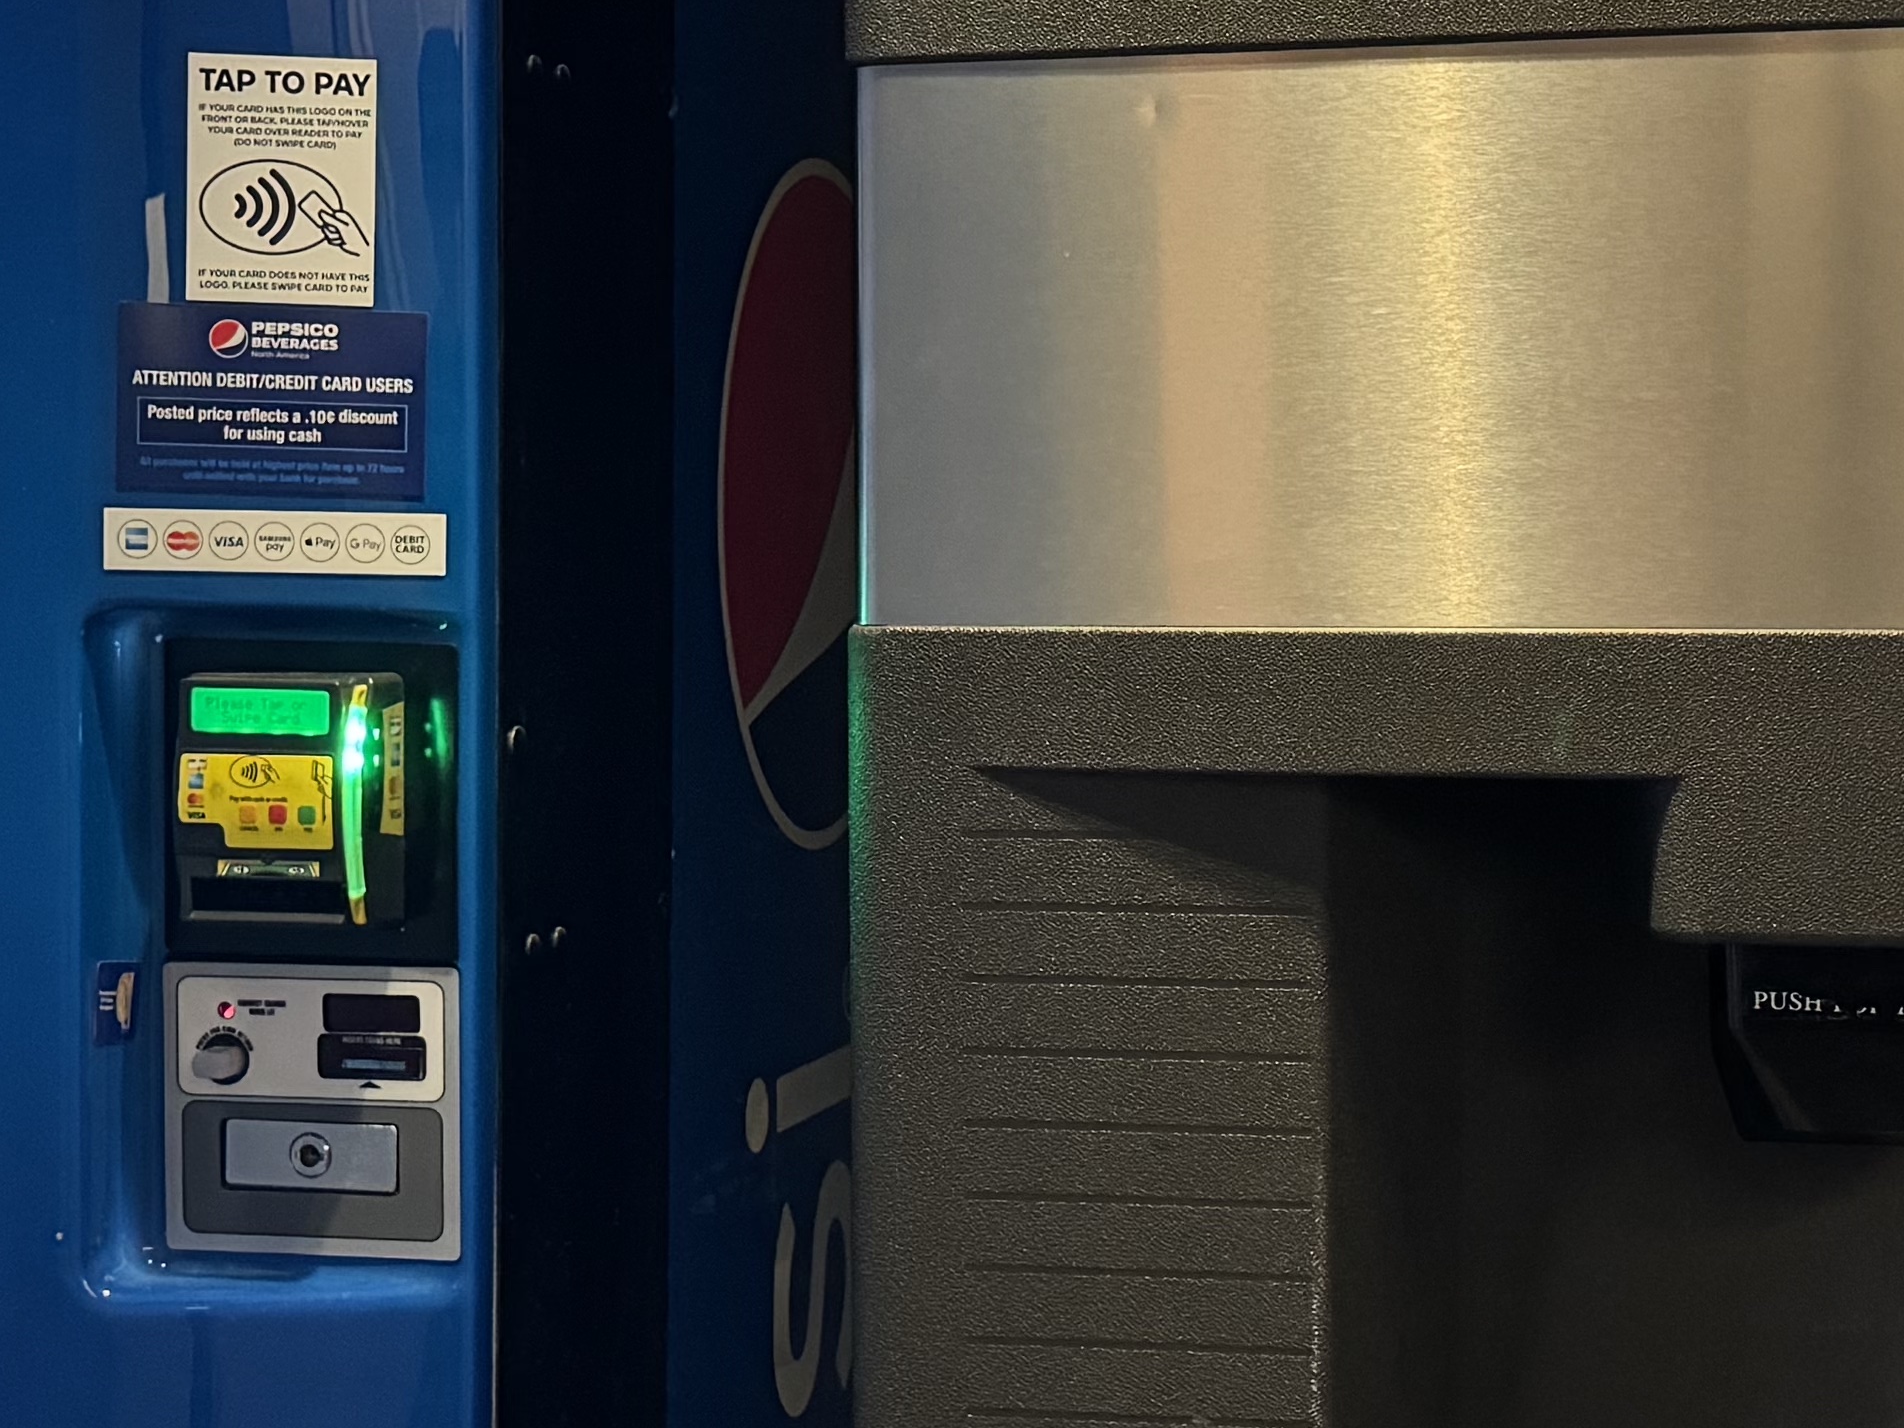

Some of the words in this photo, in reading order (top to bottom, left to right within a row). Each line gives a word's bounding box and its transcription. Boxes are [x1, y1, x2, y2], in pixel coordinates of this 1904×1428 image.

[199, 68, 256, 92] TAP
[265, 70, 305, 94] TO
[315, 72, 371, 96] PAY
[209, 104, 234, 112] YOUR
[237, 105, 263, 113] CARD
[266, 106, 284, 114] HAS
[287, 107, 306, 115] THIS
[309, 107, 336, 116] LOGO
[338, 108, 353, 116] ON
[355, 109, 371, 117] THE
[235, 115, 248, 123] OR
[280, 117, 314, 126] PLEASE
[208, 126, 233, 134] YOUR
[236, 127, 261, 135] CARD
[265, 128, 289, 136] OVER
[291, 129, 329, 137] READER
[331, 130, 343, 138] TO
[254, 139, 272, 147] NOT
[275, 139, 304, 148] SWIPE
[209, 269, 236, 277] YOUR
[239, 270, 266, 278] CARD
[269, 271, 296, 279] DOES
[299, 272, 319, 280] NOT
[322, 273, 346, 281] HAVE
[349, 274, 370, 282] THIS
[233, 282, 268, 290] PLEASE
[271, 283, 302, 291] SWIPE
[304, 284, 332, 292] CARD
[252, 322, 339, 337] PEPSICO
[252, 337, 338, 351] BEVERAGES
[132, 370, 212, 386] ATTENTION
[216, 372, 318, 391] DEBIT/CREDIT
[322, 376, 362, 392] CARD
[366, 378, 414, 394] USERS
[147, 404, 194, 420] Posted
[198, 407, 233, 424] price
[236, 408, 289, 423] reflects
[292, 413, 301, 424] a
[338, 410, 398, 425] discount
[224, 425, 243, 440] for
[247, 428, 285, 444] using
[289, 428, 322, 443] cash
[214, 536, 244, 547] VISA
[316, 537, 335, 549] Pay
[350, 538, 360, 549] G
[362, 539, 382, 551] Pay
[395, 534, 425, 545] DEBIT
[266, 542, 284, 553] pay
[395, 544, 424, 554] CARD
[1753, 991, 1822, 1012] PUSH
